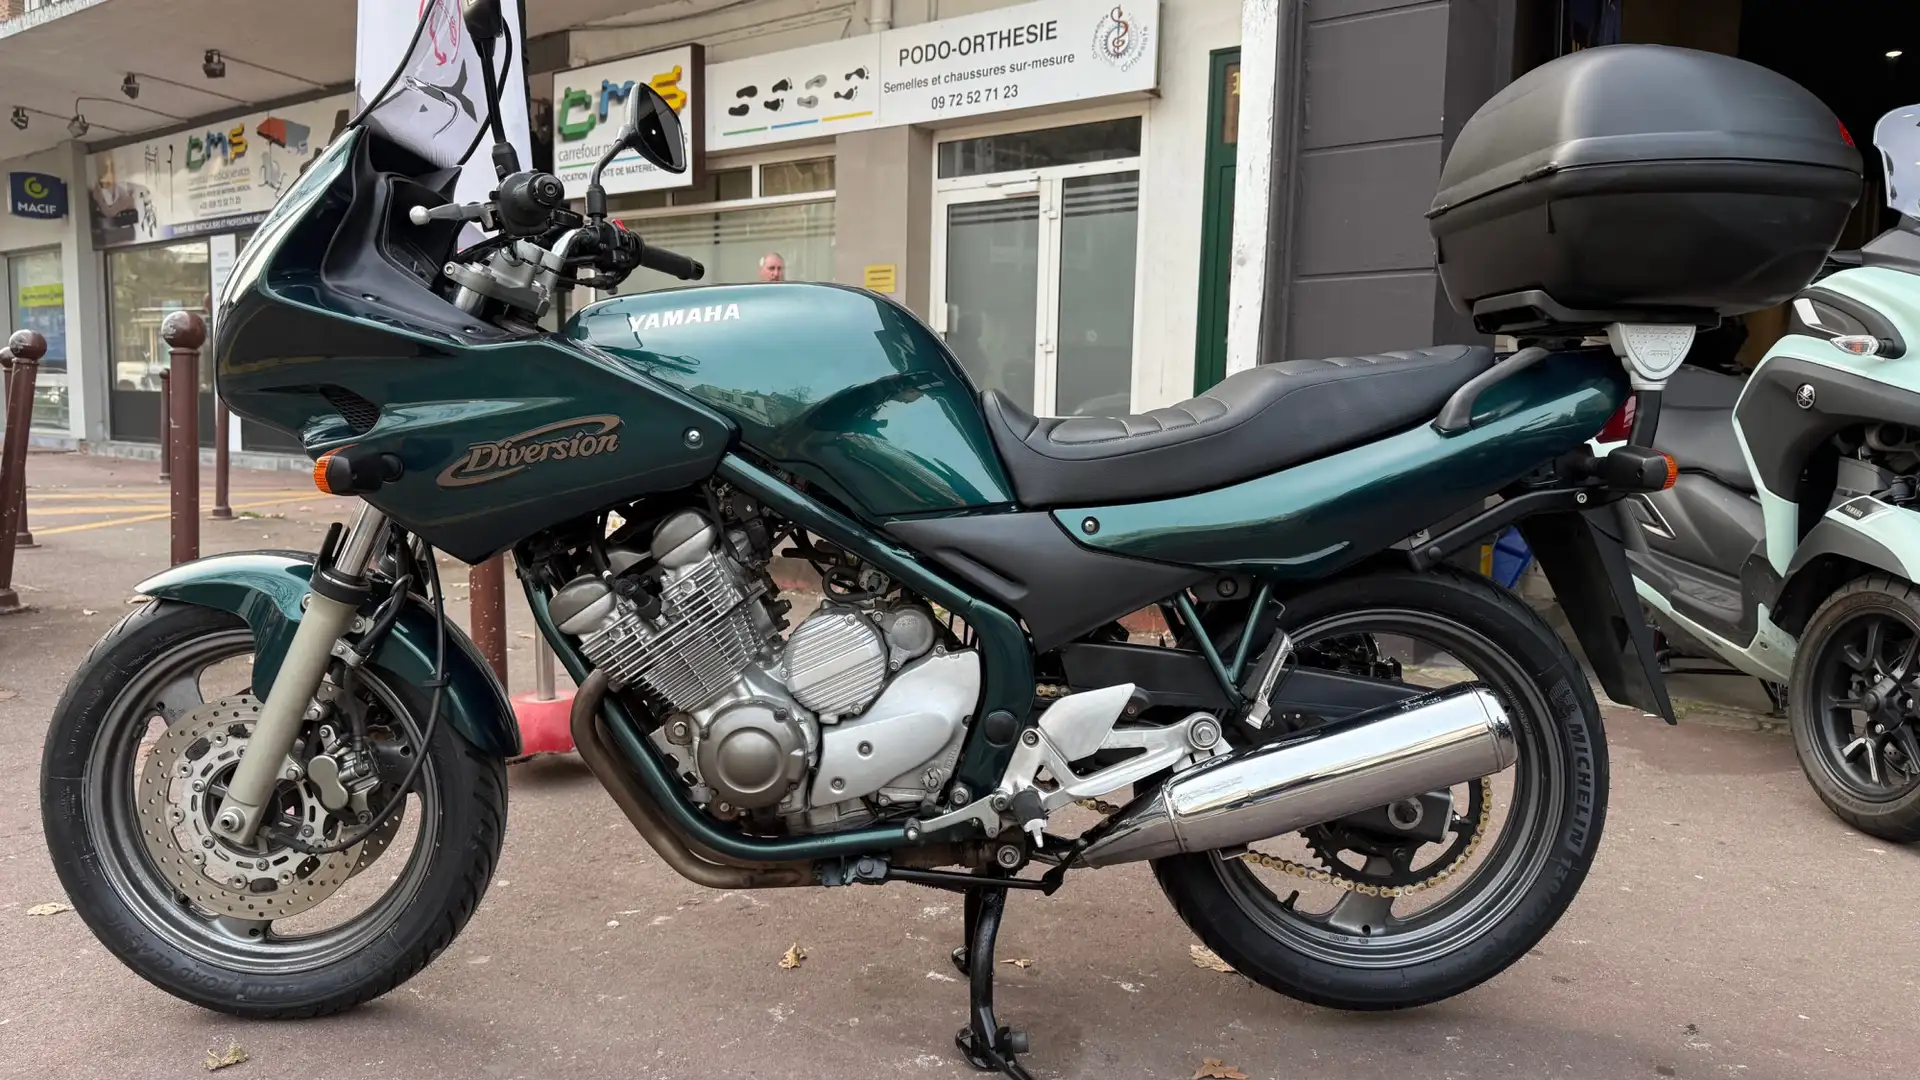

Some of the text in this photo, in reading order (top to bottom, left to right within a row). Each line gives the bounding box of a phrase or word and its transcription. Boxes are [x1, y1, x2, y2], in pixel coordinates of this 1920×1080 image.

[899, 20, 1058, 67] PODO-ORTHESIE
[883, 53, 1075, 94] Semelles et chaussures sur-mesure
[931, 84, 1018, 110] 09 72 52 71 23
[558, 143, 601, 162] carrefour
[17, 200, 57, 214] MACIF
[629, 303, 740, 333] YAMAHA
[461, 430, 619, 473] Diversion
[1567, 723, 1592, 848] MICHELIN
